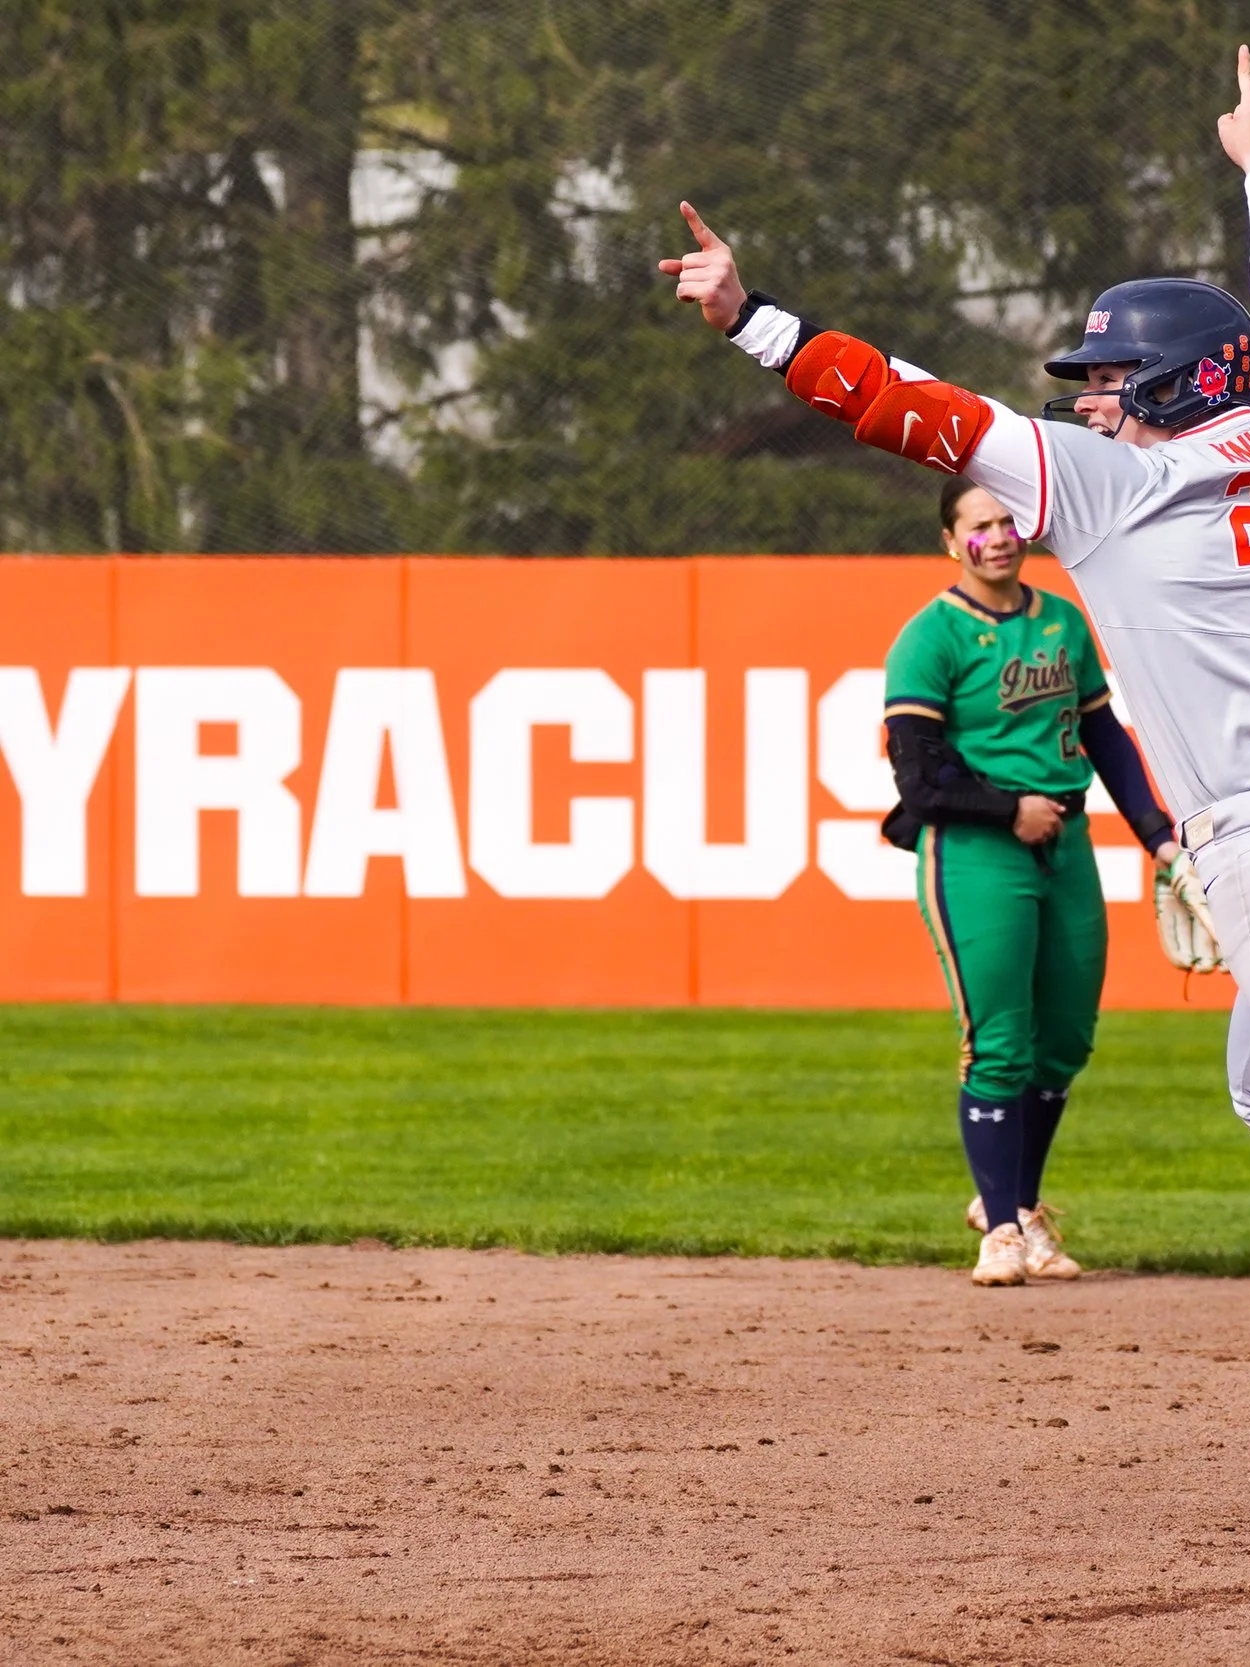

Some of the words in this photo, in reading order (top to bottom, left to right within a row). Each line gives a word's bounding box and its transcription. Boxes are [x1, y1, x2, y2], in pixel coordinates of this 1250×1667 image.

[1223, 344, 1234, 360] S
[999, 647, 1076, 700] Irish
[1058, 706, 1081, 762] 2
[0, 665, 1143, 902] YRACU
